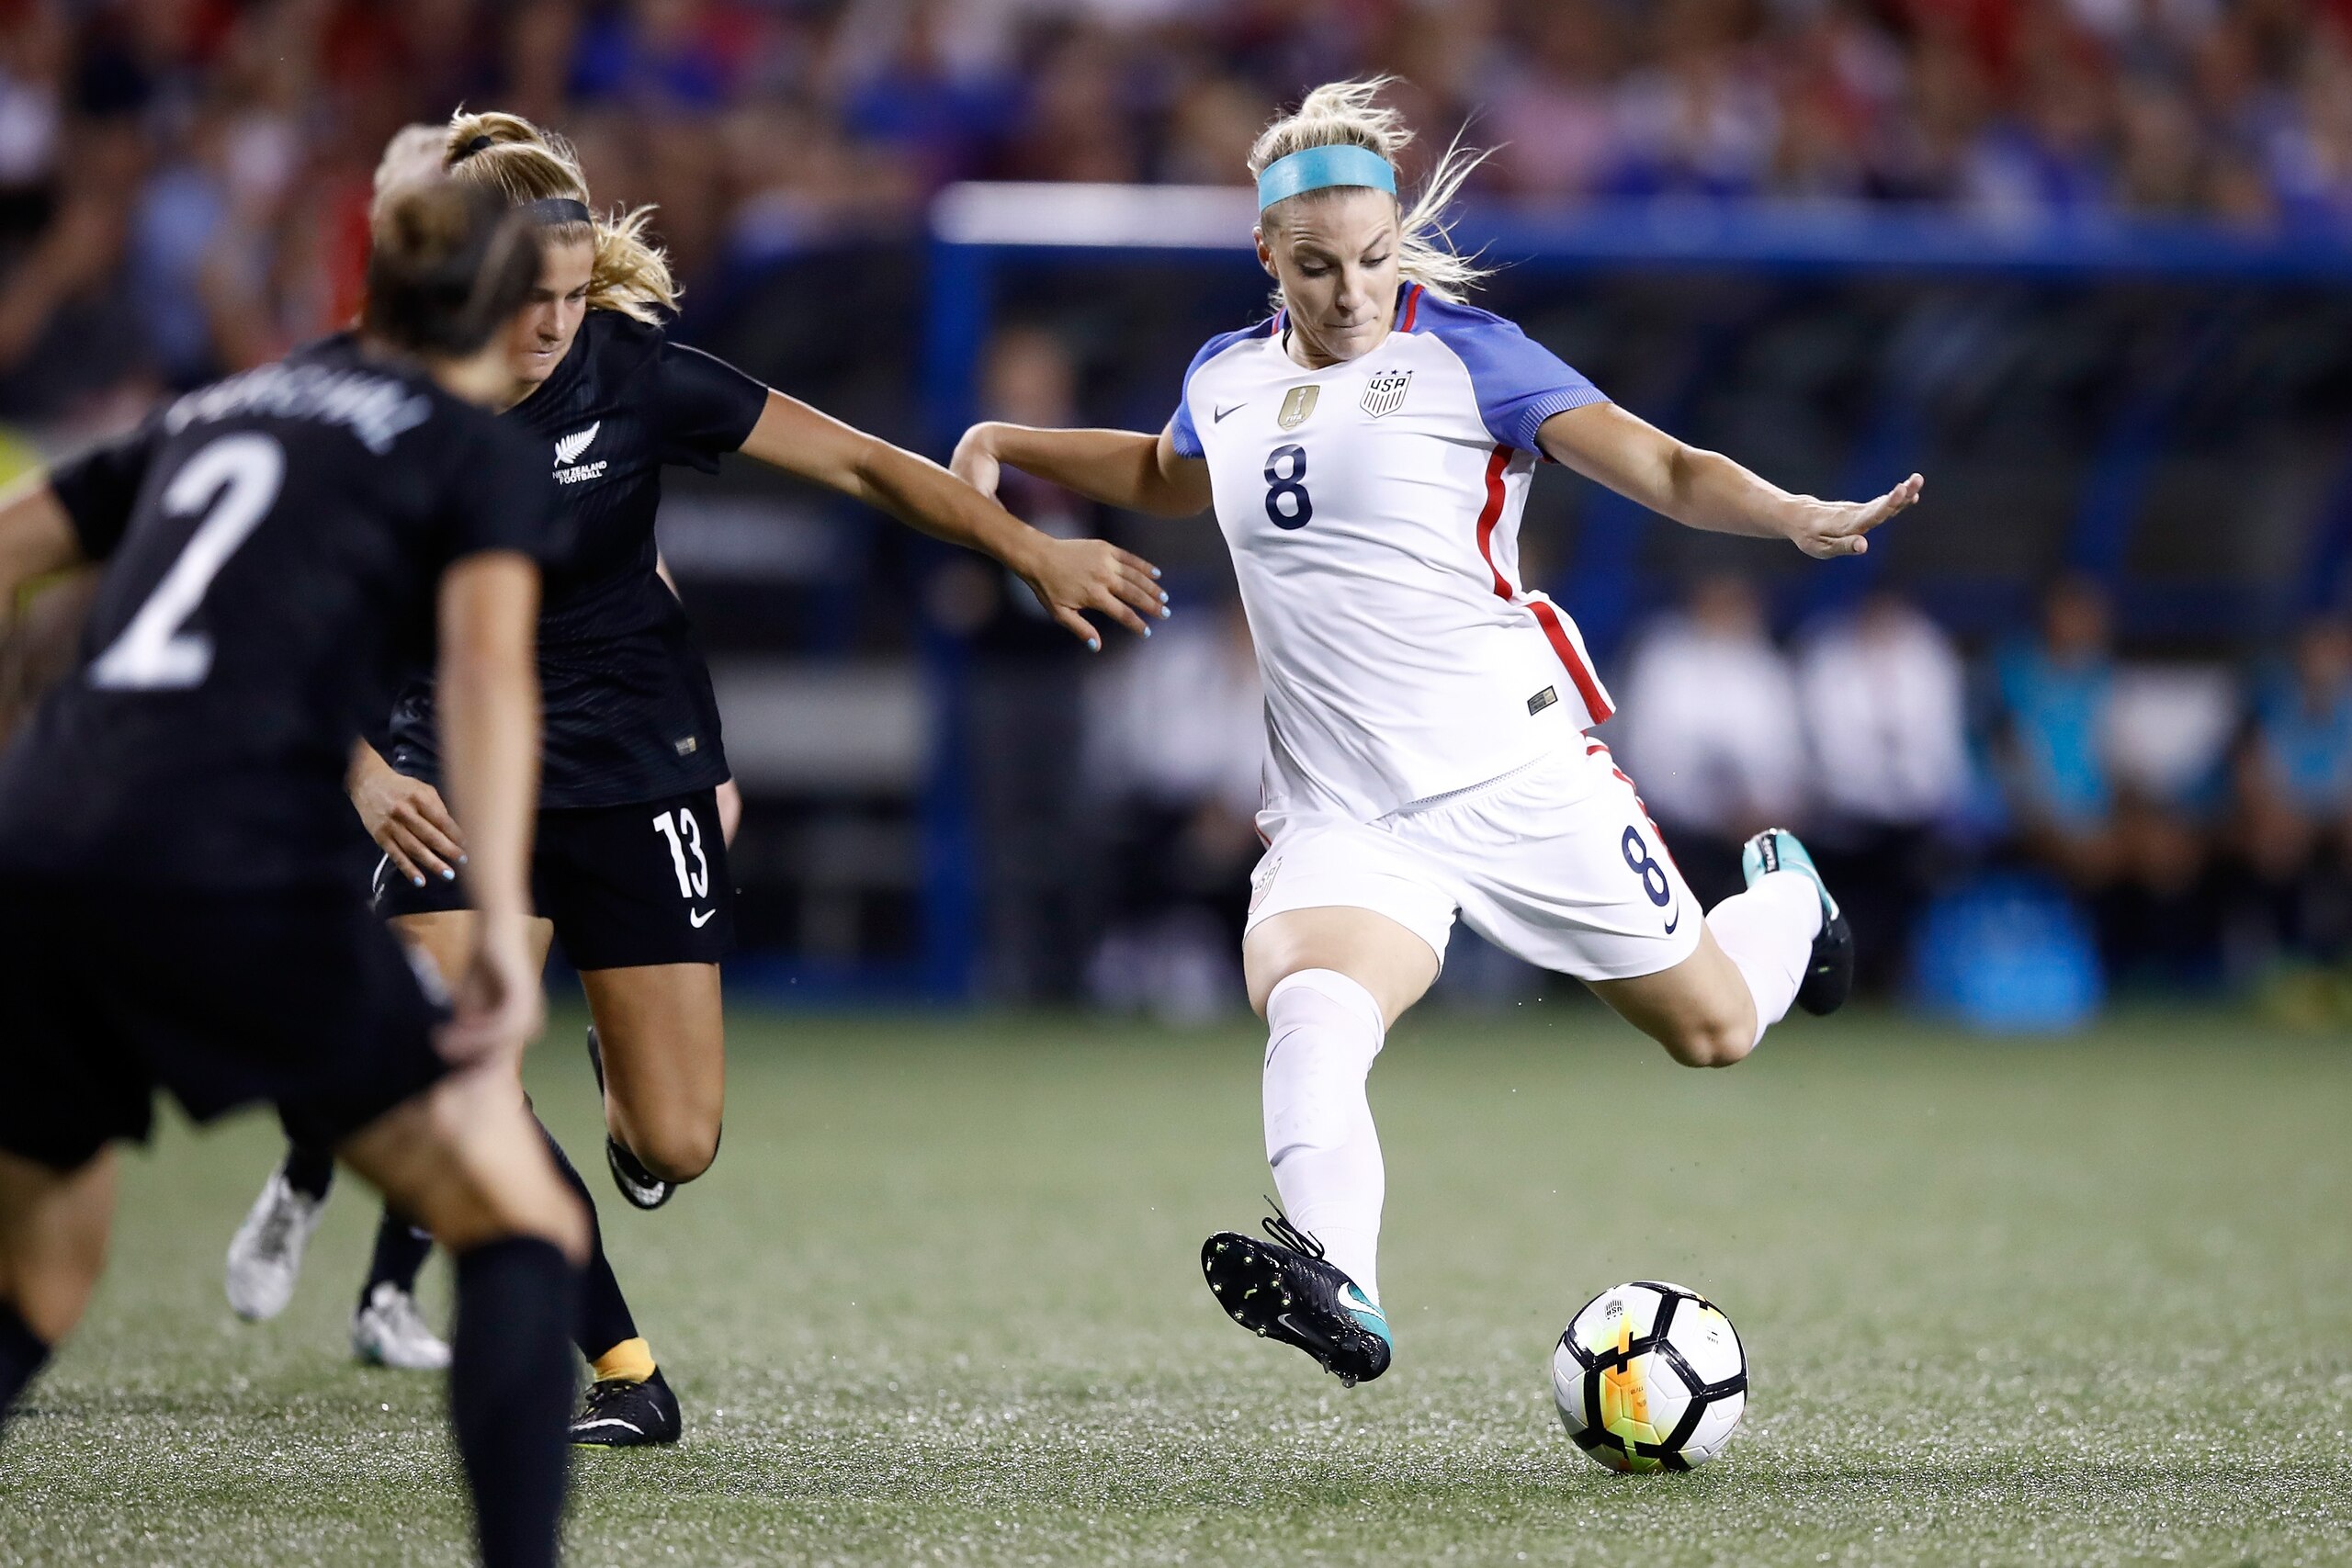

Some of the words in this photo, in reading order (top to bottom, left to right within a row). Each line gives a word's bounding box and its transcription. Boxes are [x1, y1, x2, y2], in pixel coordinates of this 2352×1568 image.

[1371, 378, 1407, 392] USA
[1286, 414, 1303, 423] FIFA
[552, 468, 570, 479] NEW
[571, 460, 607, 475] ZEALAND
[560, 469, 603, 485] FOOTBALL
[1264, 444, 1313, 530] 8
[88, 434, 286, 692] 2
[652, 807, 708, 898] 13
[1622, 825, 1669, 907] 8
[1606, 1306, 1623, 1316] USA
